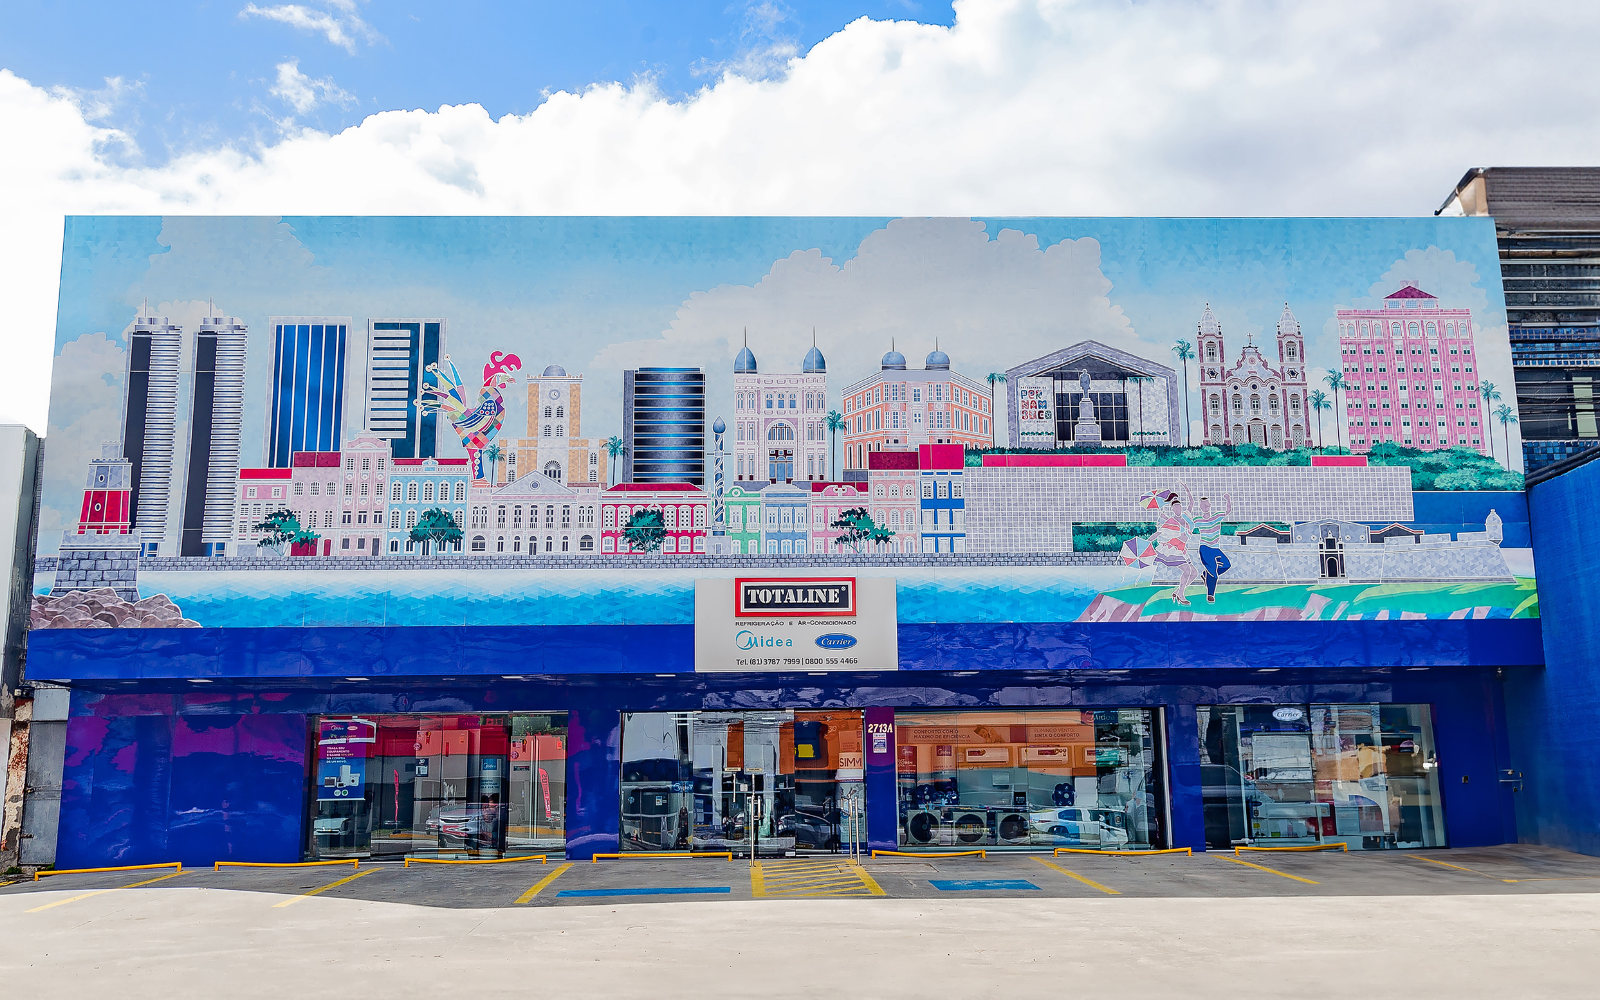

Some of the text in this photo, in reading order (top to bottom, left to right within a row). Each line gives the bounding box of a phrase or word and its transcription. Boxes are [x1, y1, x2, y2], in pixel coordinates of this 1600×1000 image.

[1021, 400, 1047, 409] NAM
[736, 630, 793, 650] Midea
[821, 638, 852, 646] Carrier
[868, 723, 892, 733] 2713A
